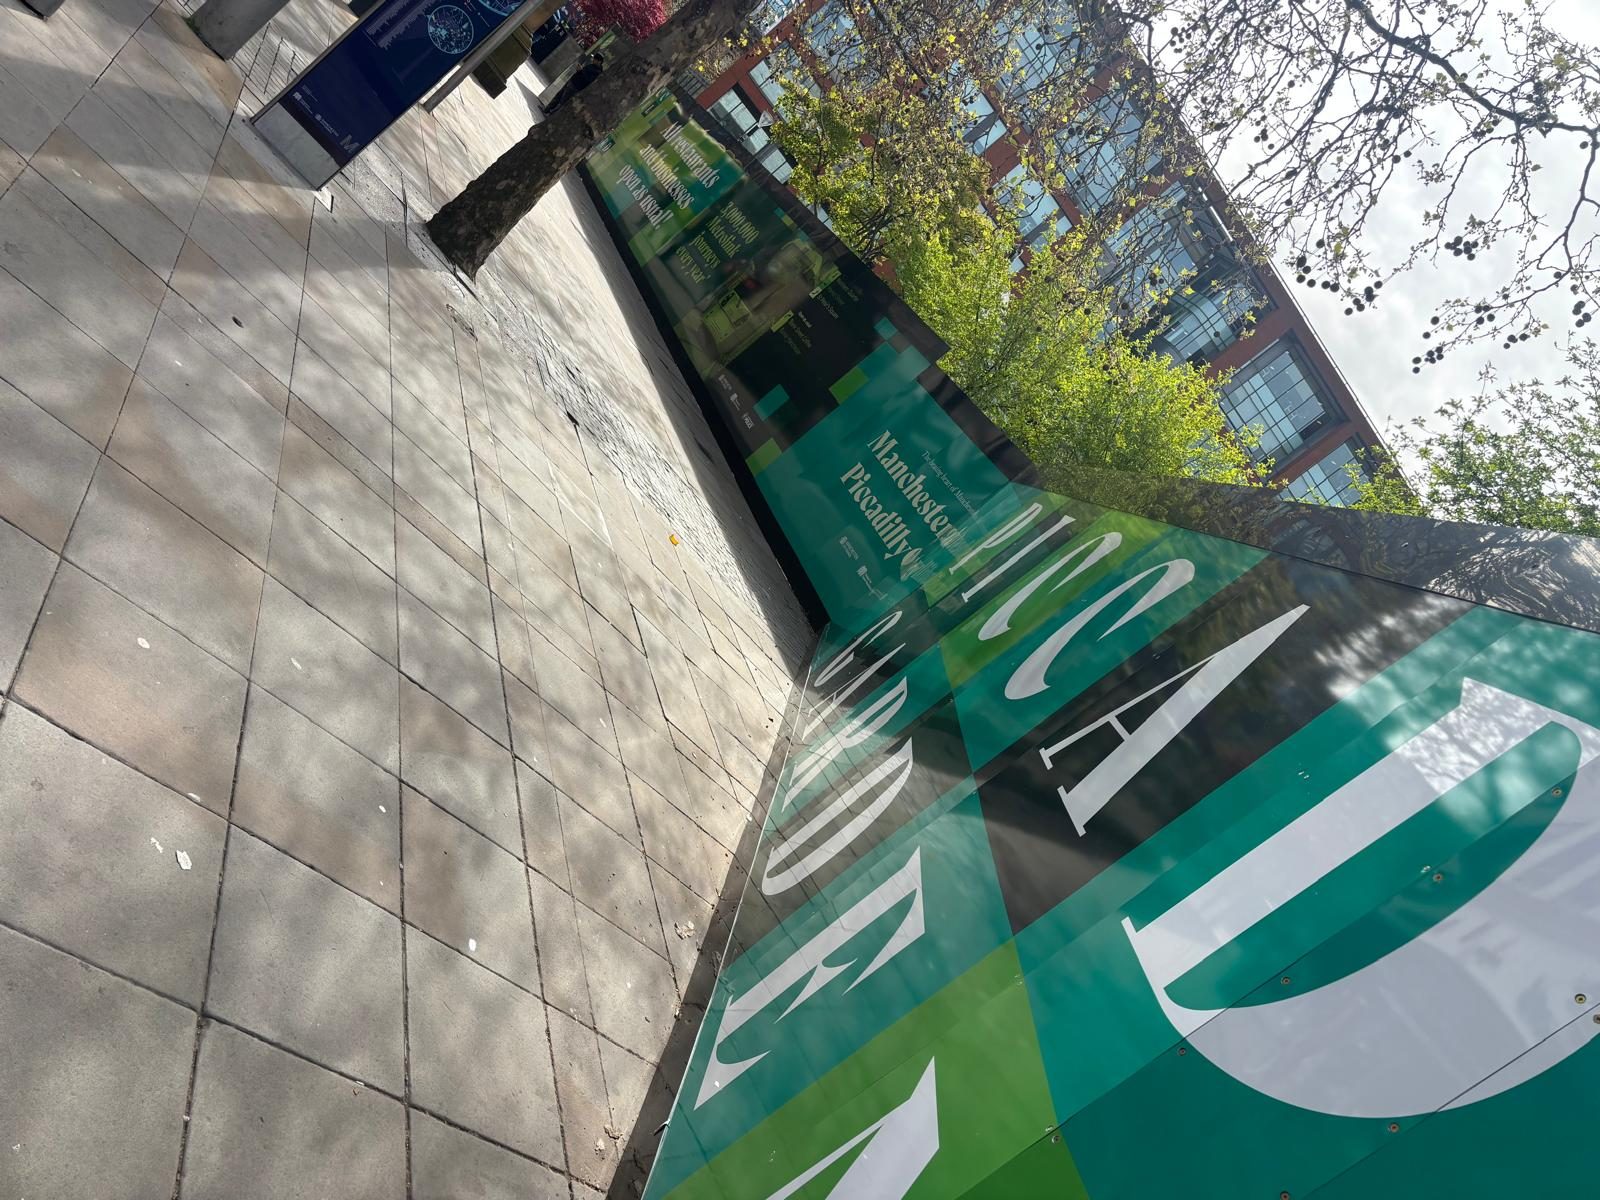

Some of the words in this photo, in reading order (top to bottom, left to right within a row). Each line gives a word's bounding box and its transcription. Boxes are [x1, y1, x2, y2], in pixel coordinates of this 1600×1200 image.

[660, 121, 683, 142] All
[640, 144, 664, 166] and
[670, 135, 720, 188] restaurants
[616, 164, 641, 191] open
[632, 185, 648, 200] as
[651, 154, 694, 209] businesses
[639, 195, 674, 230] usual!
[689, 231, 720, 268] journeys
[705, 215, 741, 258] Metrolink
[867, 430, 953, 542] Manchester
[840, 462, 912, 560] Piccadilly
